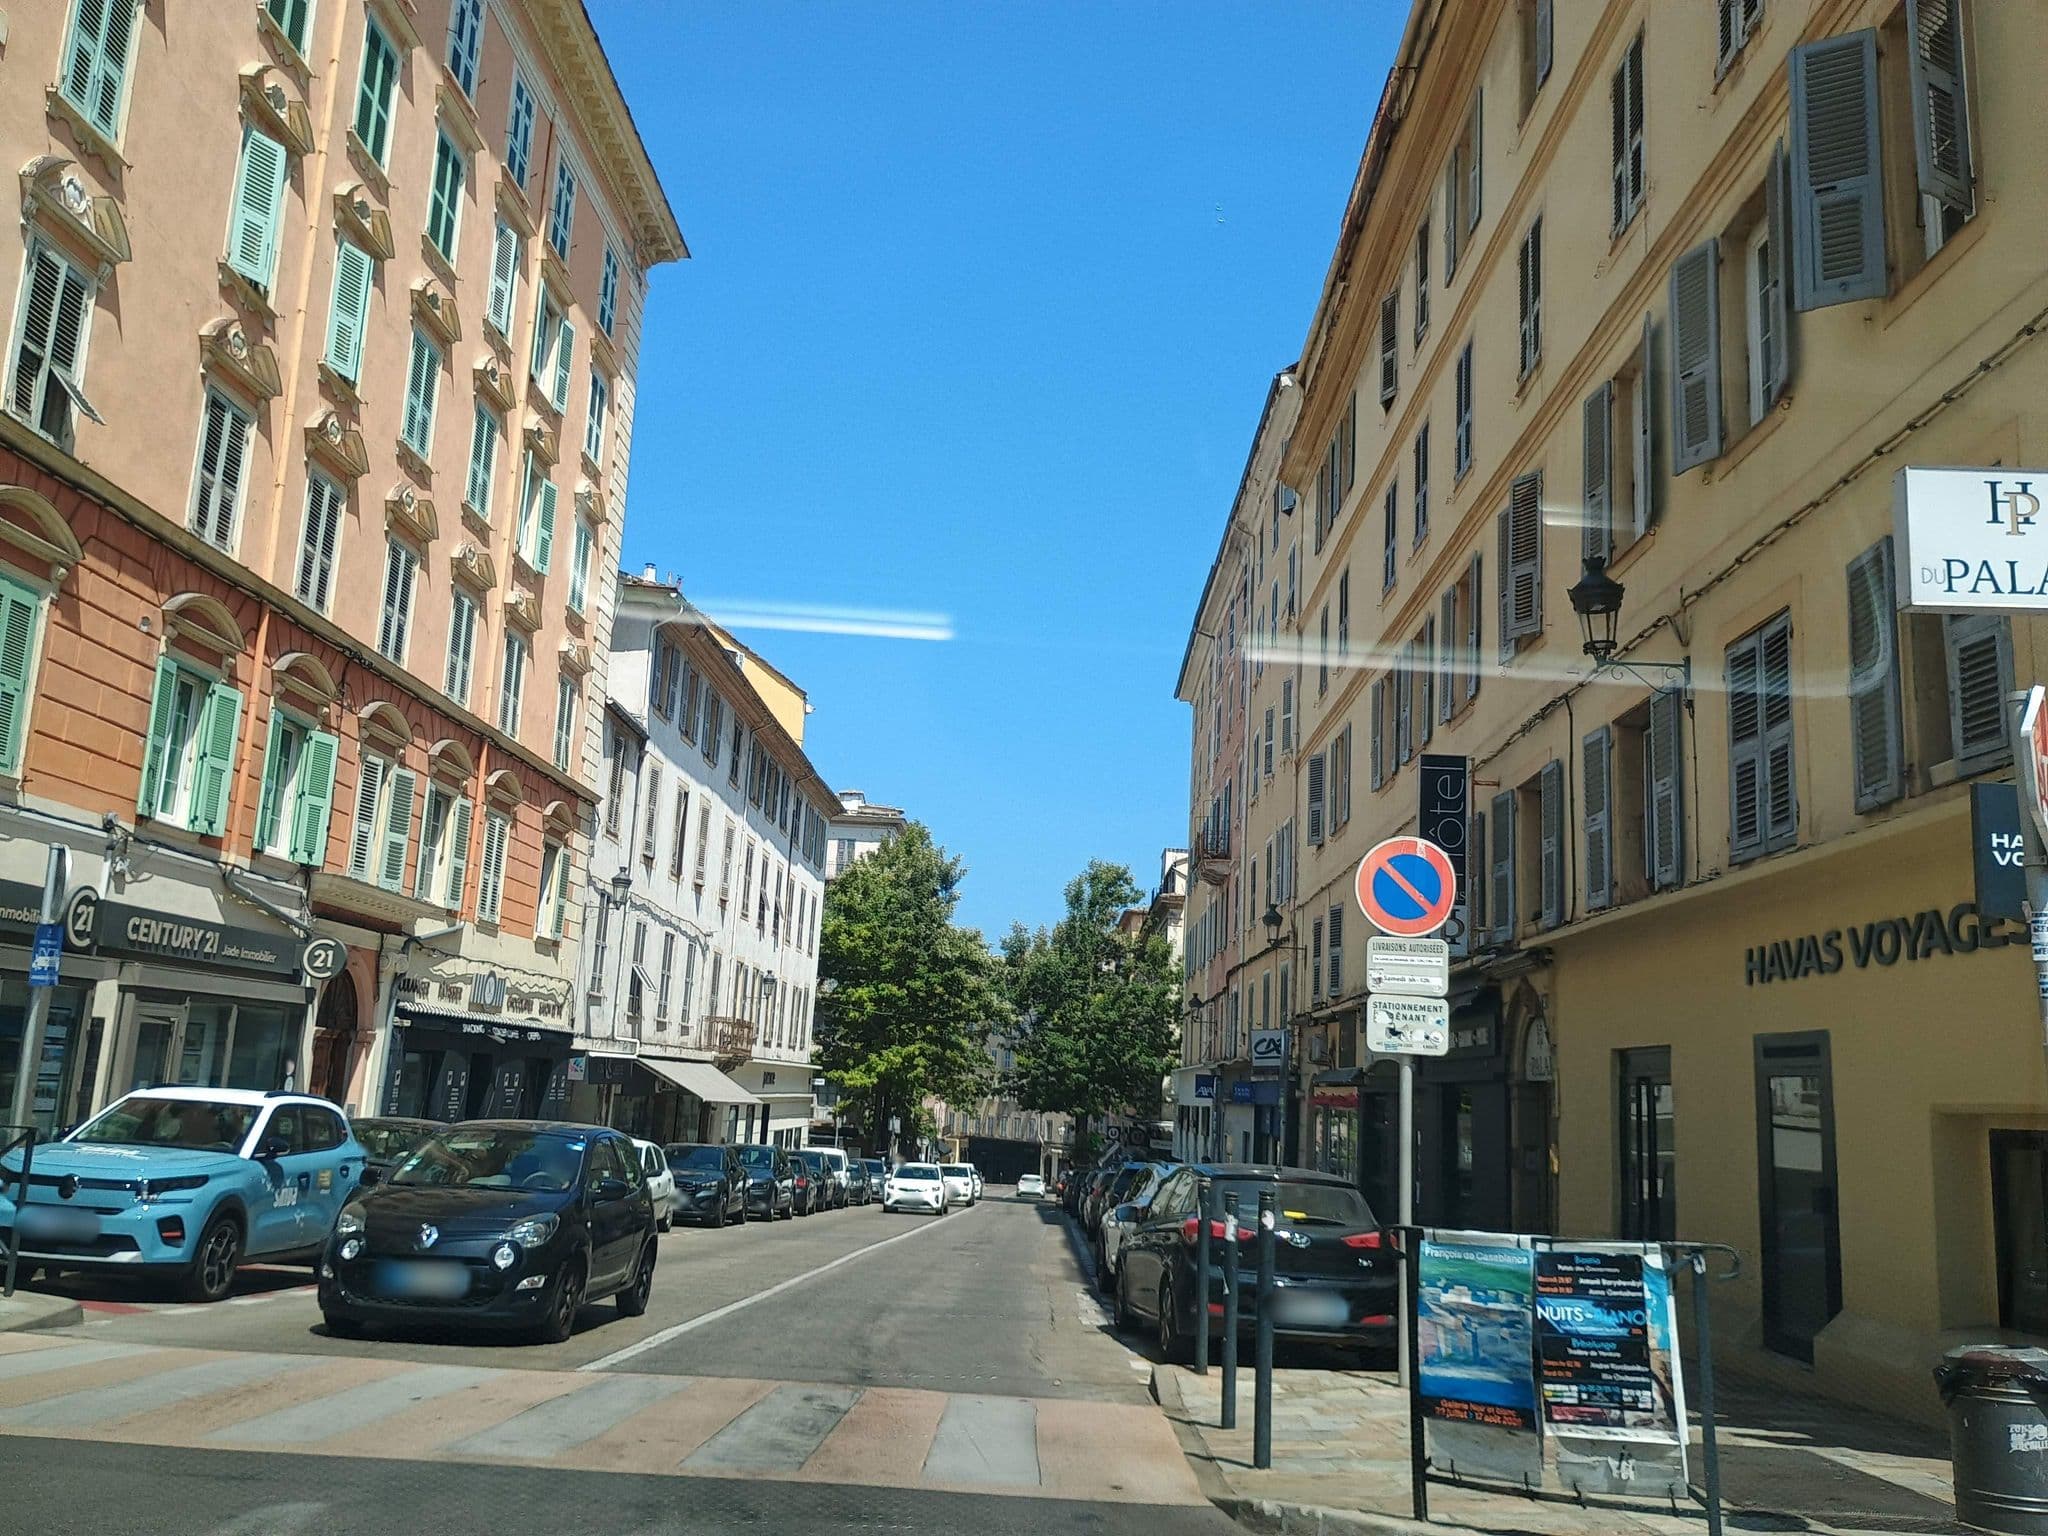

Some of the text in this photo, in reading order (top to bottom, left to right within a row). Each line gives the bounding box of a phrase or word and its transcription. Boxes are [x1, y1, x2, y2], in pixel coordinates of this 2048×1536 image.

[1921, 567, 1945, 584] DU
[127, 916, 220, 954] CENTURY 21
[240, 946, 277, 964] Immobilier
[1373, 942, 1406, 952] LIVRAISONS
[1744, 929, 1843, 986] HAVAS
[1373, 1001, 1443, 1013] STATIONNEMENT
[1390, 1012, 1426, 1023] ÊNANT
[1424, 1246, 1528, 1264] François de Casablanca
[1536, 1304, 1584, 1322] NUITS
